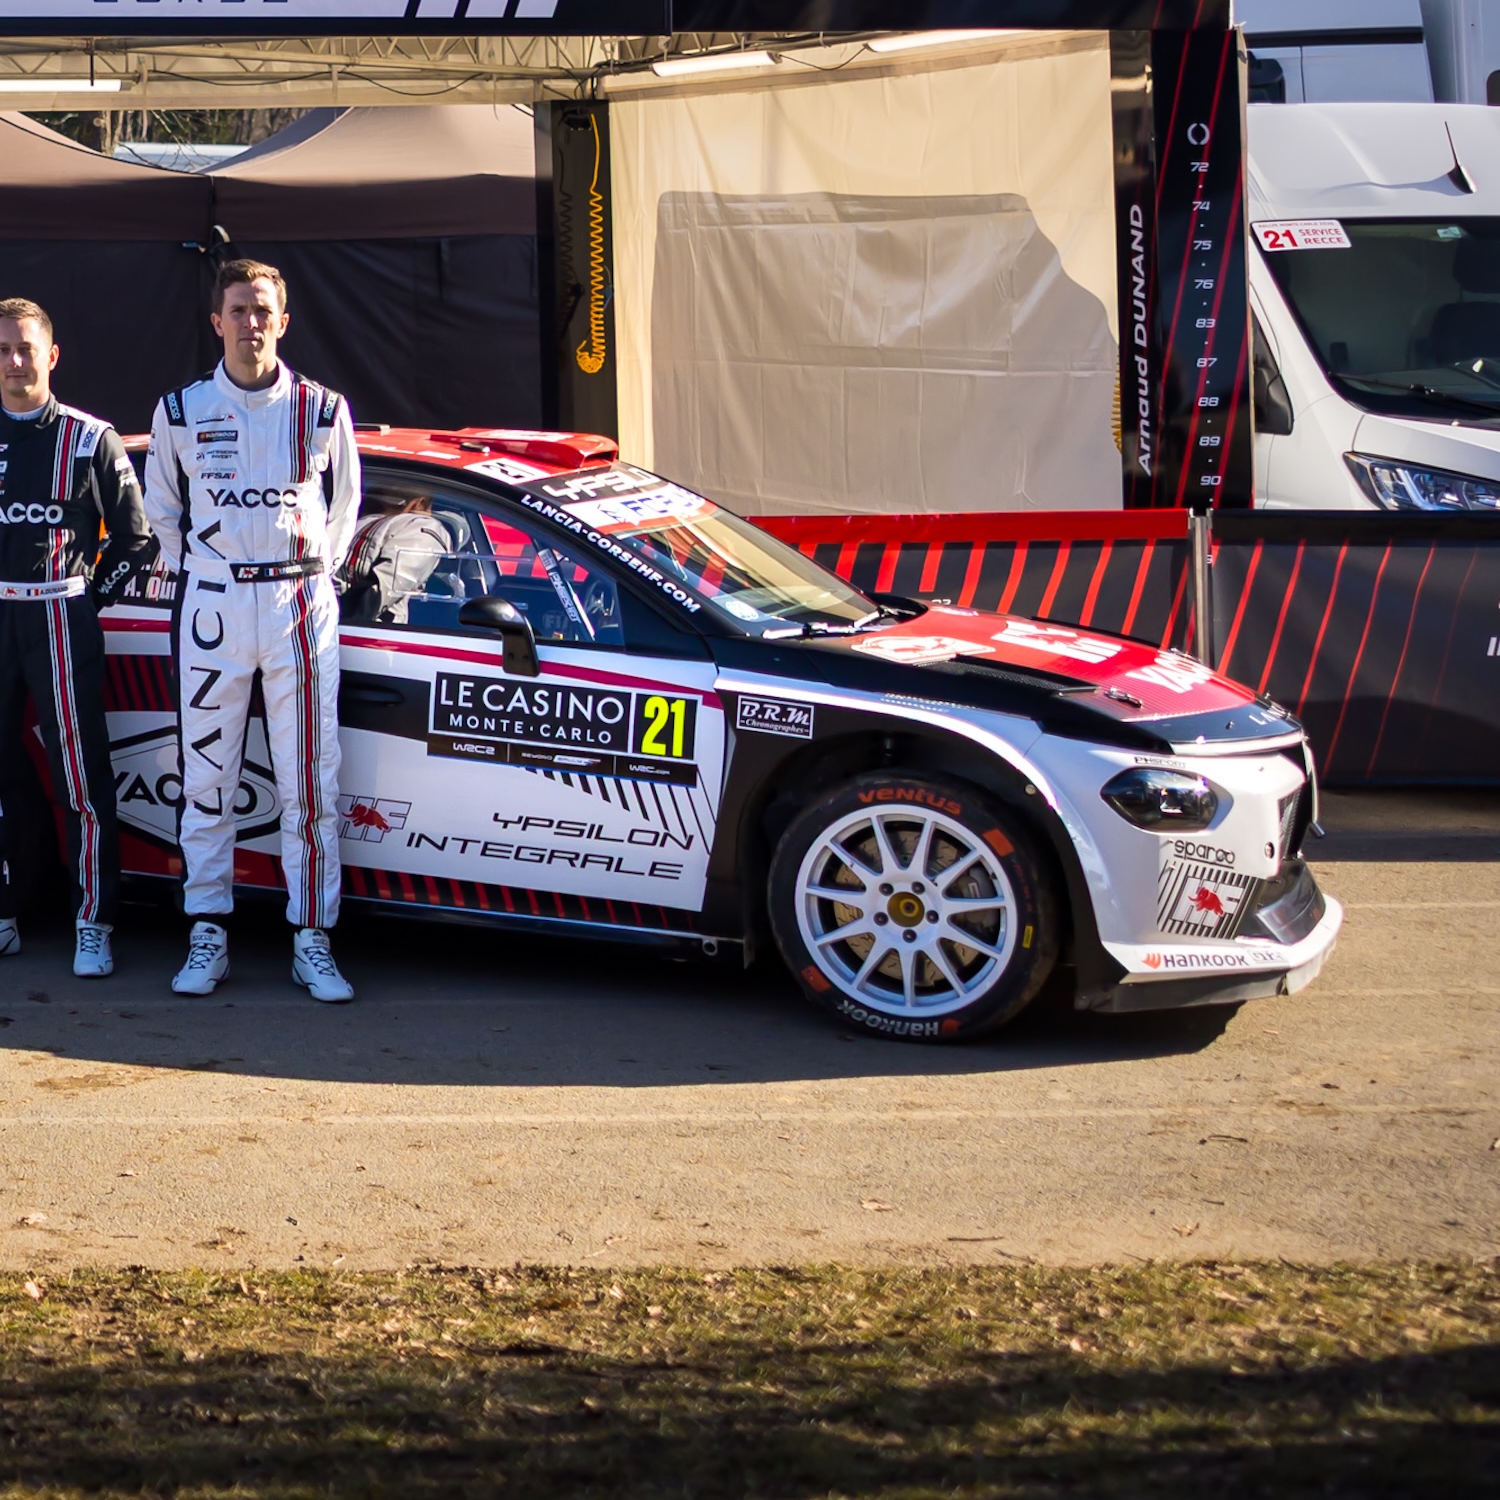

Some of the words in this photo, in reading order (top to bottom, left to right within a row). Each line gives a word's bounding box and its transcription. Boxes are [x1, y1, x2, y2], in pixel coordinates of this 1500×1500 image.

[1190, 162, 1209, 172] 72
[1191, 201, 1210, 211] 74
[1299, 228, 1342, 237] SERVICE
[1193, 240, 1212, 250] 75
[1263, 229, 1298, 249] 21
[1303, 236, 1345, 245] RECCE
[1129, 204, 1148, 348] DUNAND
[1194, 280, 1213, 289] 76
[1195, 318, 1216, 329] 83
[1196, 357, 1218, 368] 87
[1198, 397, 1219, 407] 88
[1131, 355, 1153, 477] Arnaud
[1199, 436, 1220, 446] 89
[1200, 475, 1222, 485] 90
[520, 494, 702, 614] LANCIA-CORSEHF.COM
[440, 678, 473, 708] LE
[482, 684, 625, 726] CASINO
[449, 712, 524, 735] MONTE
[538, 723, 612, 745] CARLO
[641, 696, 685, 757] 21
[452, 742, 495, 755] WRC2
[492, 812, 695, 851] YPSILON
[405, 832, 684, 881] INTEGRALE
[1173, 838, 1236, 866] sparco
